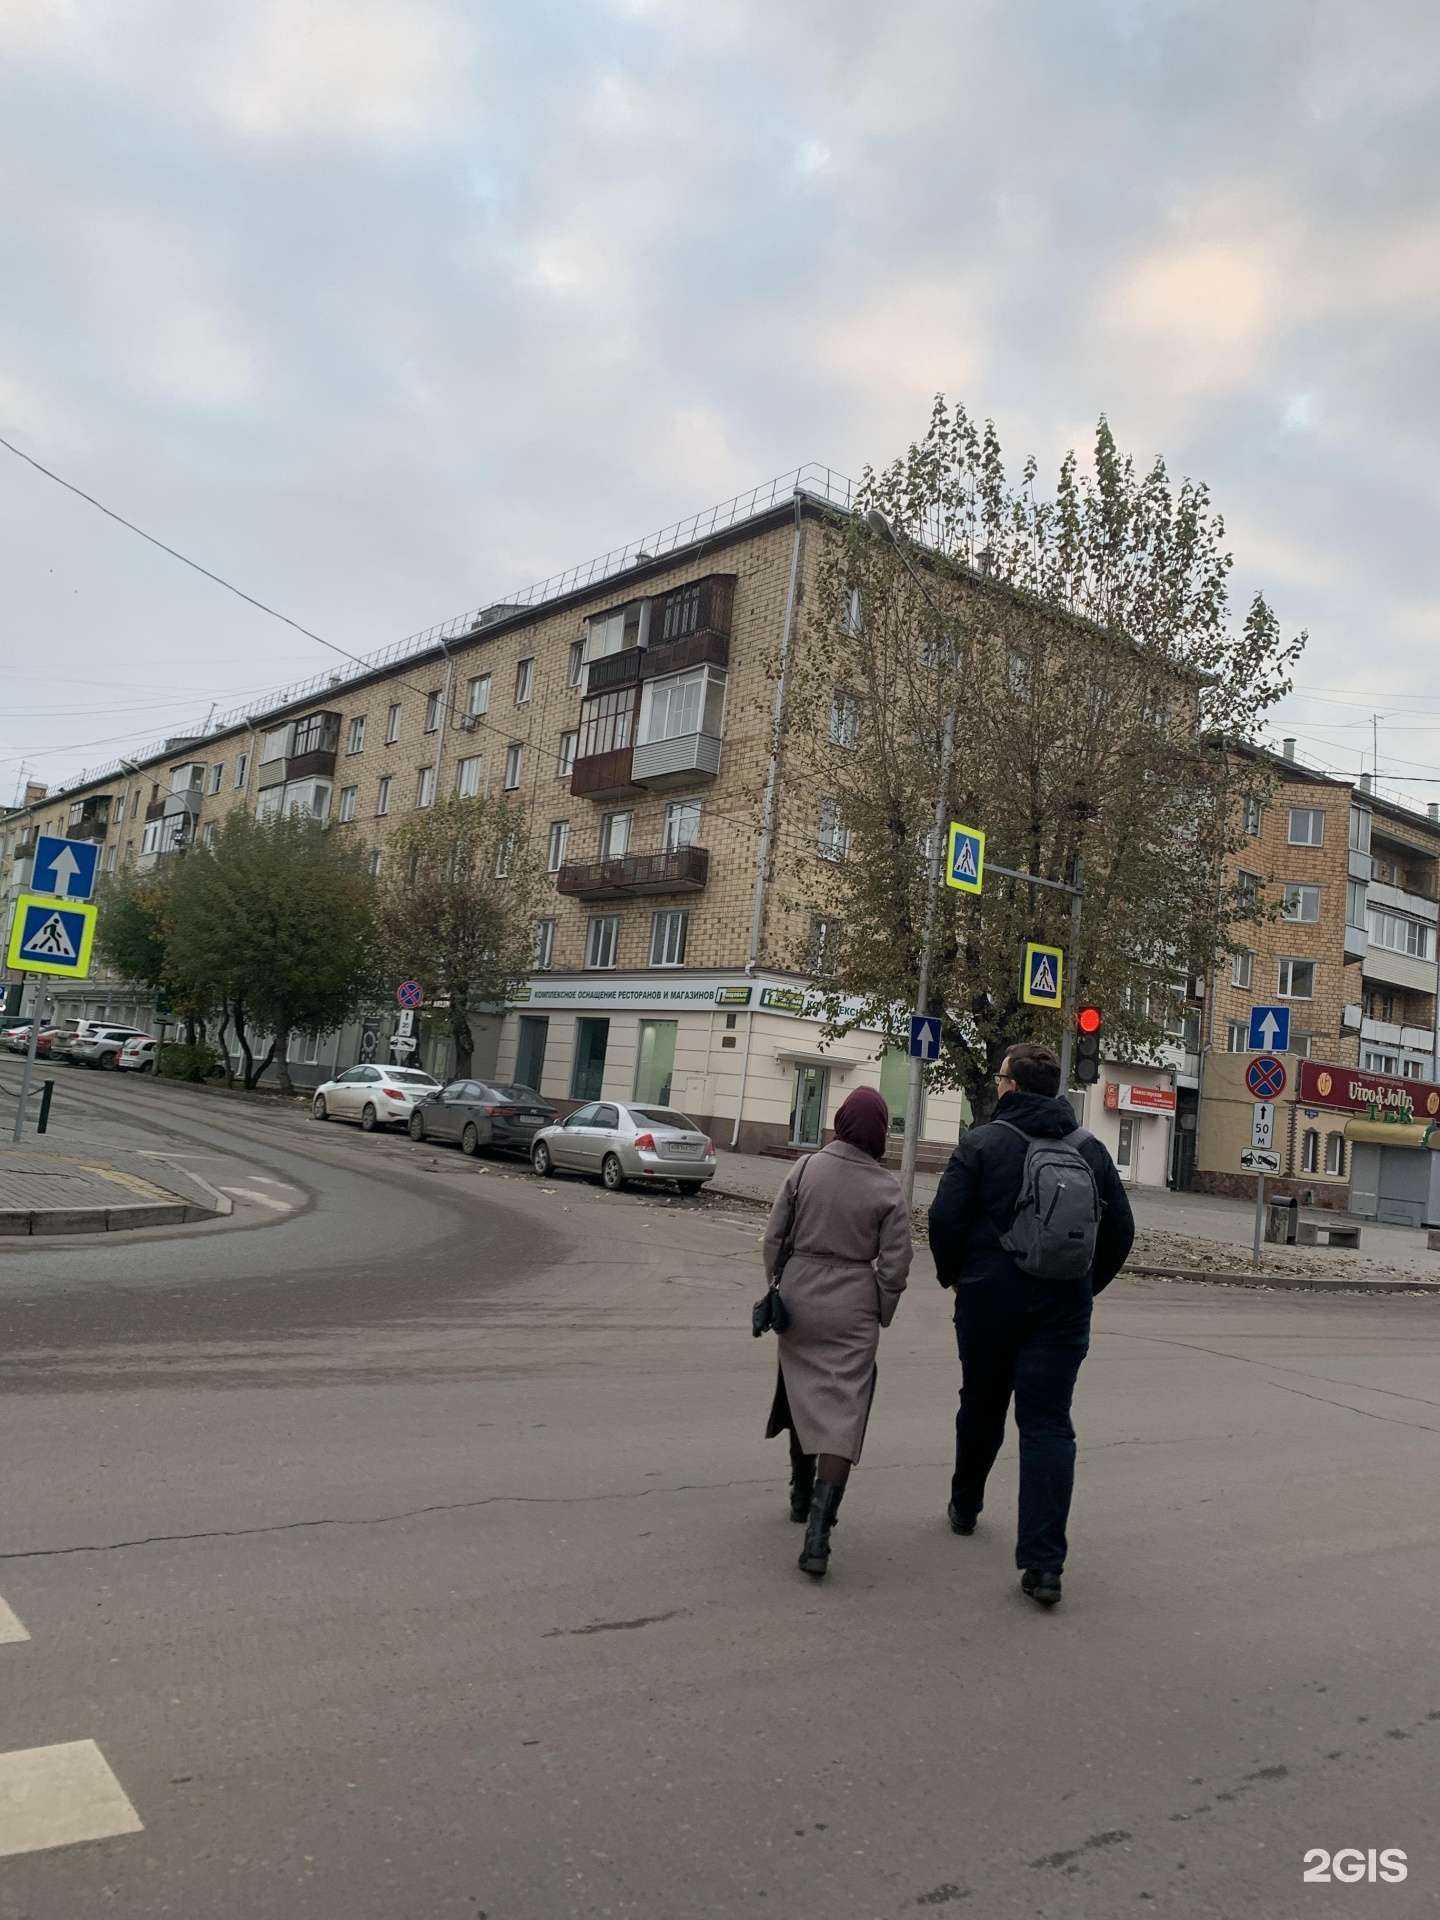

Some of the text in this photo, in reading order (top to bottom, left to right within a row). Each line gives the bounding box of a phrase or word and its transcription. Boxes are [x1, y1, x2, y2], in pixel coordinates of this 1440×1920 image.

[534, 991, 577, 999] КОМПЛЕКСНОЕ
[577, 990, 617, 999] ОСНАЩЕНИЕ
[617, 991, 662, 1000] РЕСТОРАНОВ
[663, 991, 669, 1000] И
[669, 990, 714, 1000] МАГАЗИНОВ
[1255, 1123, 1269, 1134] 50
